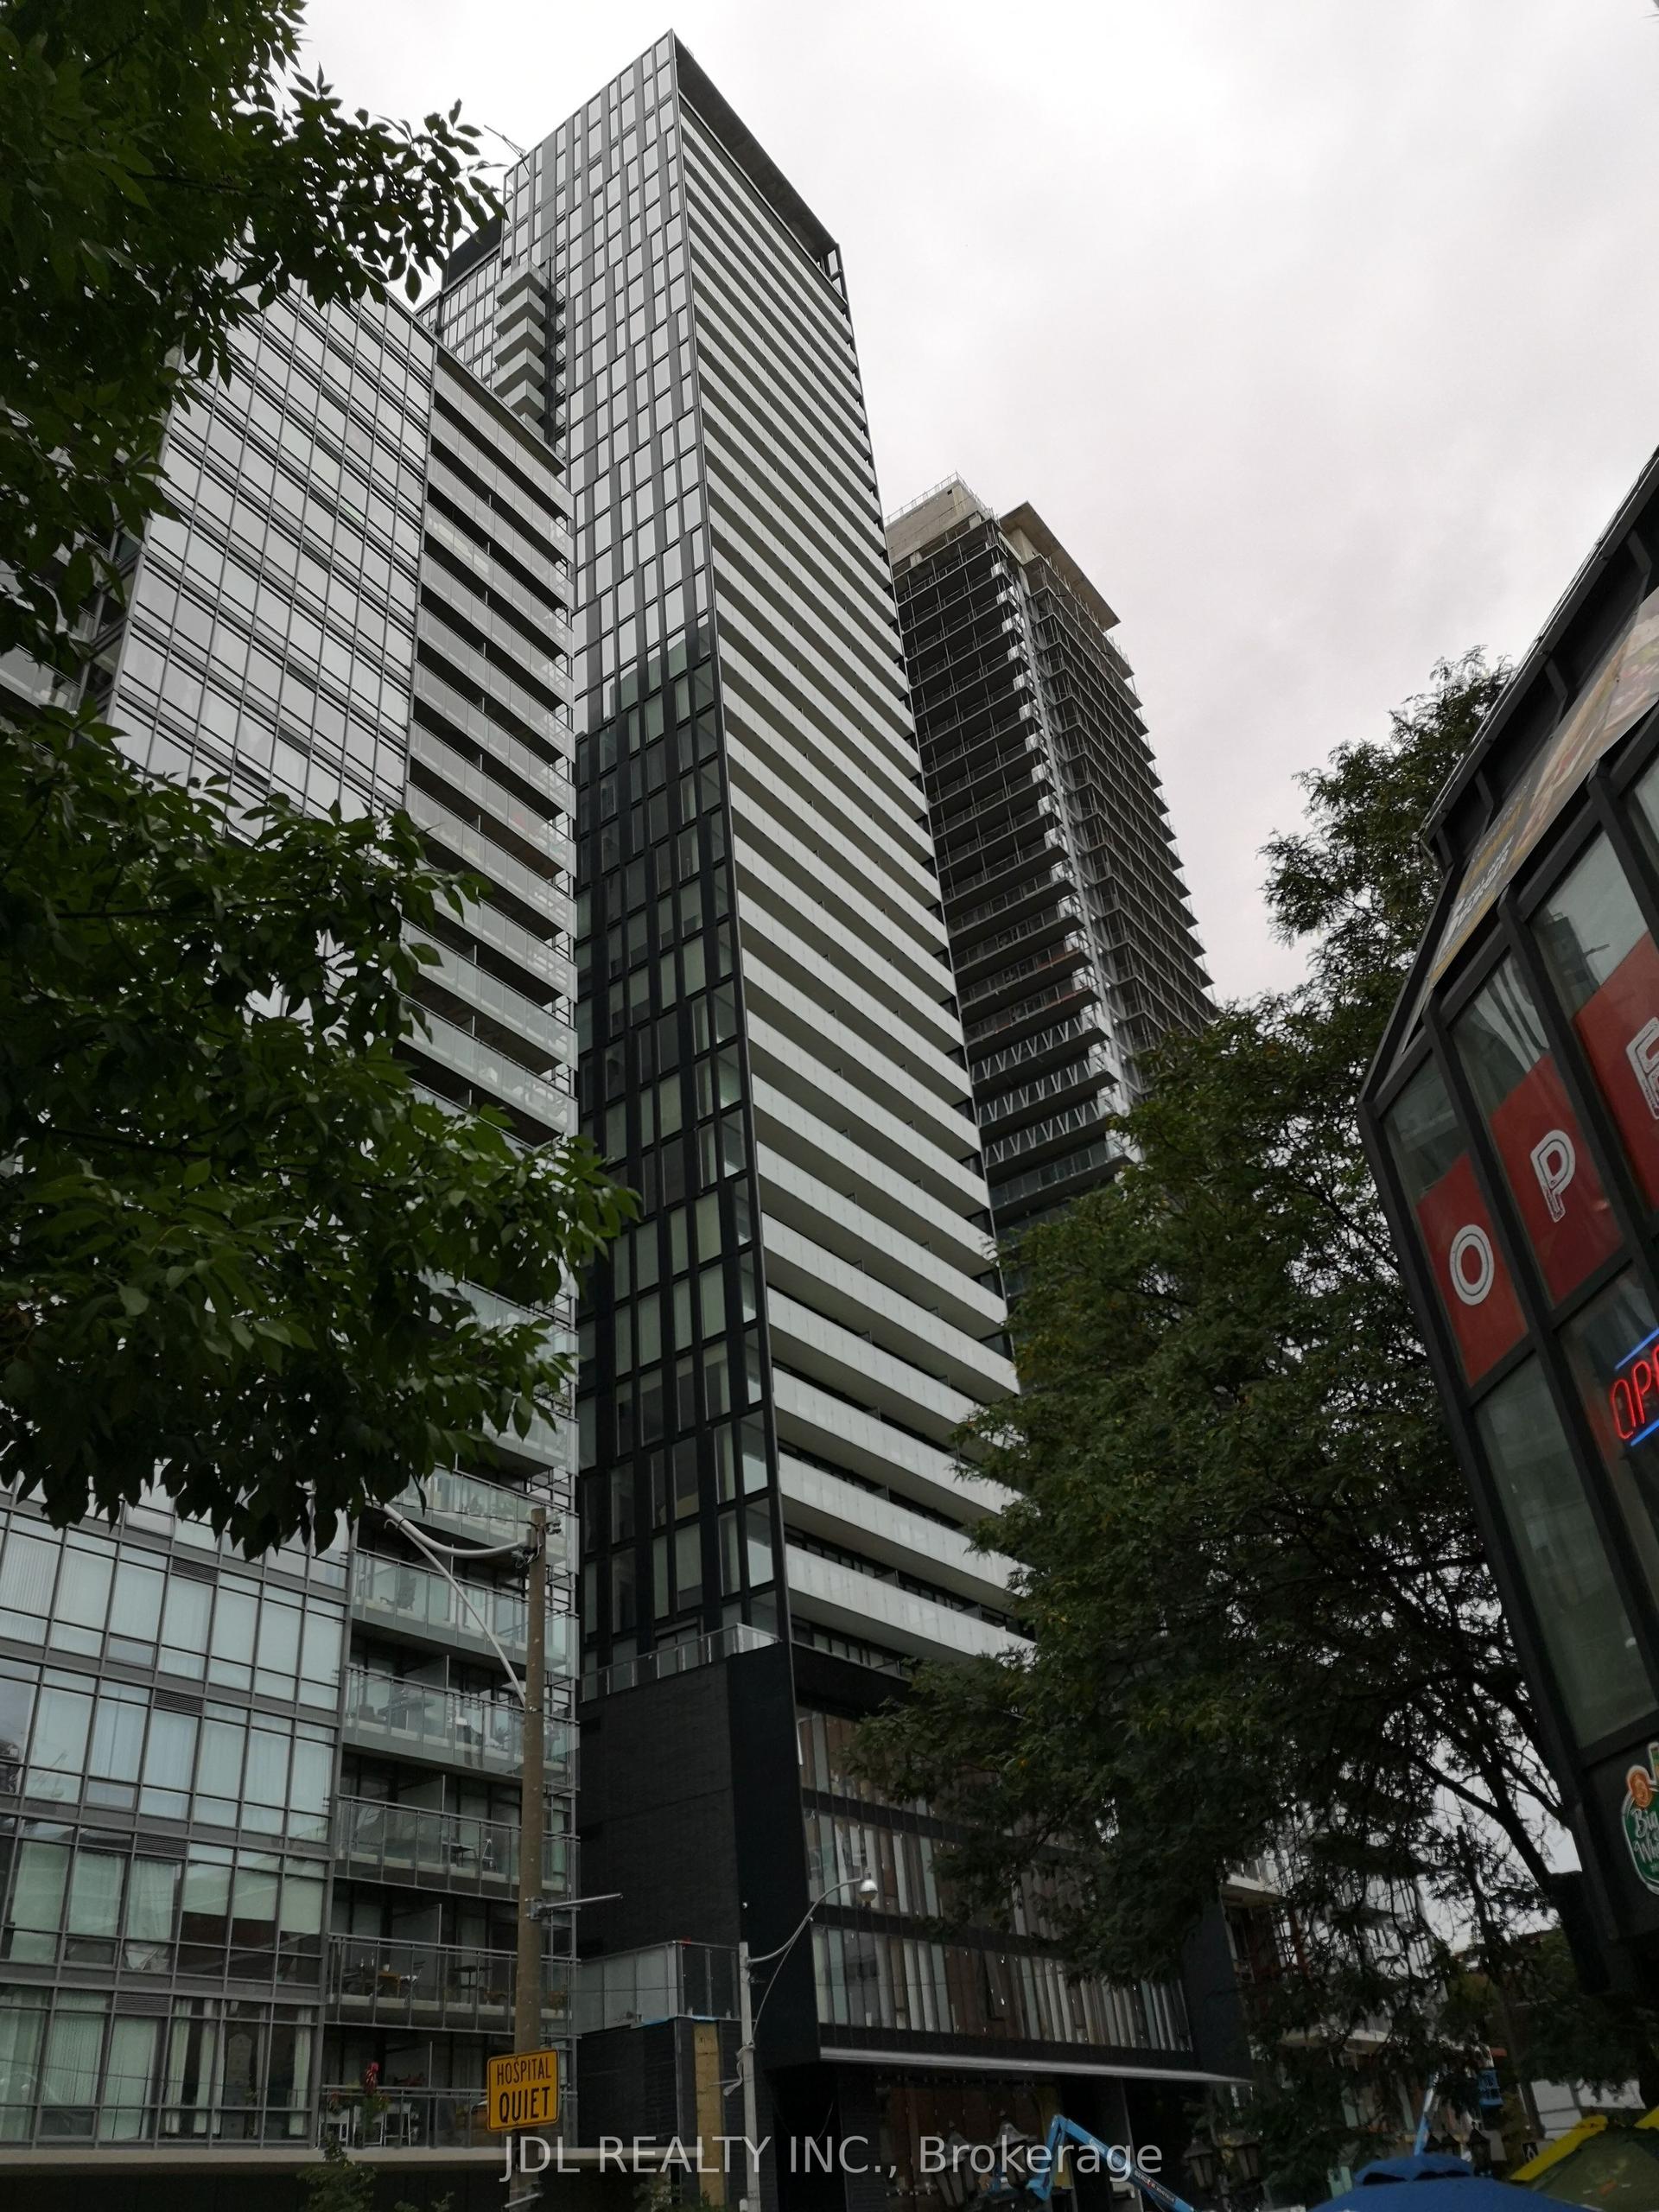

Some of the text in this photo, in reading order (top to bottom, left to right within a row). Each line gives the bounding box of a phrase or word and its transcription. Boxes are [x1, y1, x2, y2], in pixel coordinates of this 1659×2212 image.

[1610, 1344, 1659, 1440] OP
[497, 2057, 551, 2085] HOSPITAL
[499, 2086, 550, 2123] QUIET
